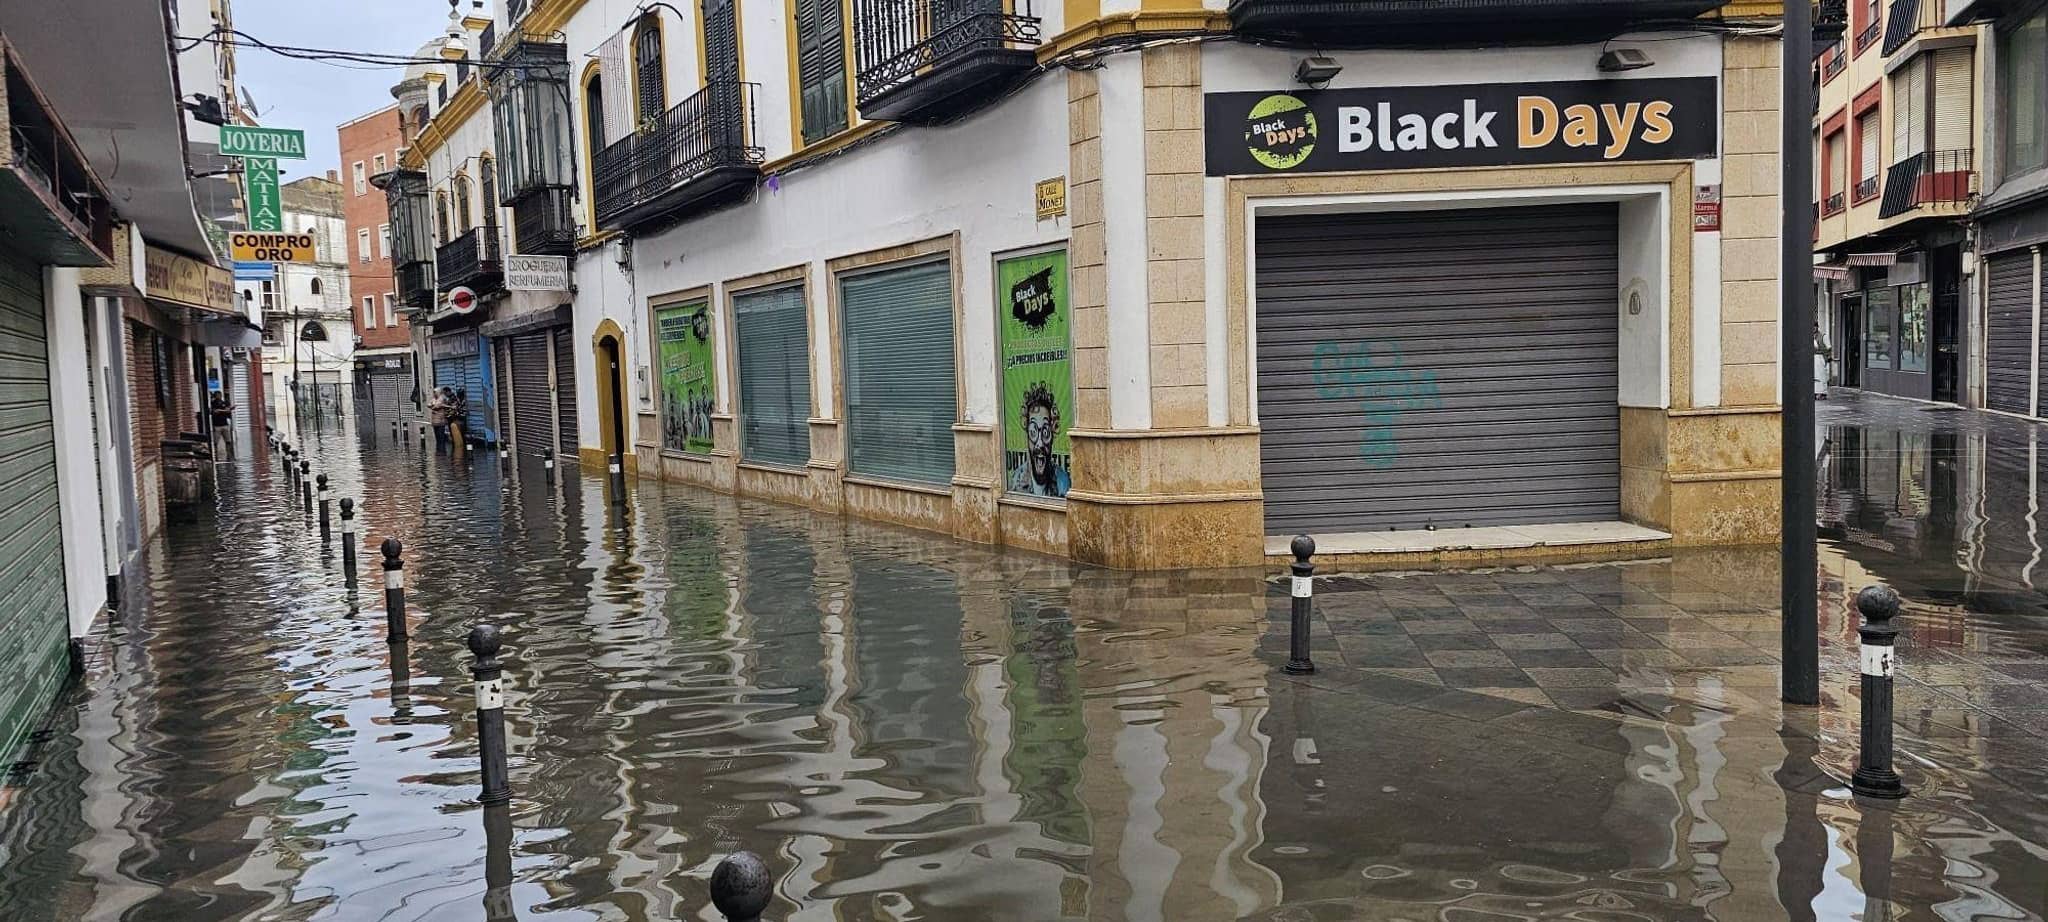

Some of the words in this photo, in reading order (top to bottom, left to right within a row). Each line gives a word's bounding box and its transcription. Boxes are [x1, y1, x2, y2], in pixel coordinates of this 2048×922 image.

[1252, 119, 1286, 135] Black
[1337, 98, 1499, 153] Black
[1517, 95, 1674, 159] Days
[223, 130, 303, 153] JOYERIA
[1265, 126, 1306, 146] Days
[251, 158, 277, 231] MATIAS
[1040, 197, 1063, 210] MONET
[233, 234, 311, 248] COMPRO
[255, 249, 293, 261] ORO
[508, 259, 565, 272] DROGUERIA
[508, 274, 566, 287] PERFUMERIA
[1016, 285, 1036, 302] Black
[1024, 292, 1049, 315] Days
